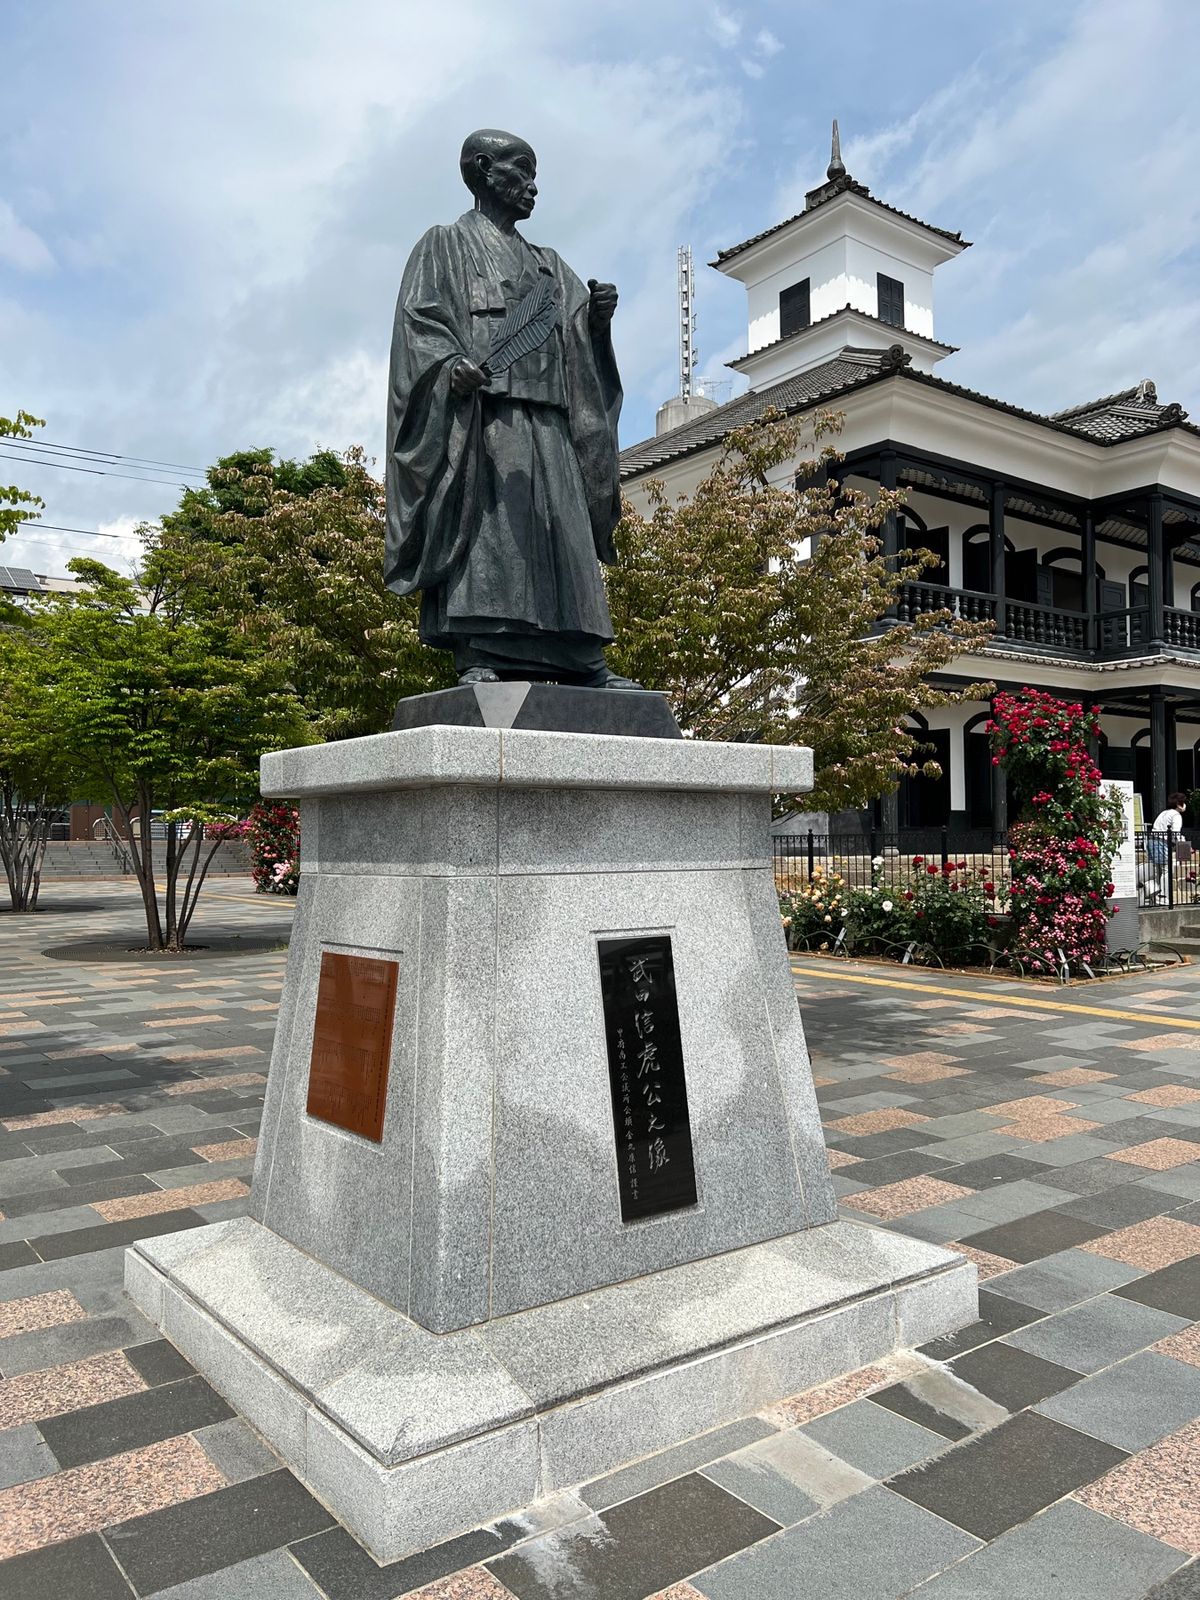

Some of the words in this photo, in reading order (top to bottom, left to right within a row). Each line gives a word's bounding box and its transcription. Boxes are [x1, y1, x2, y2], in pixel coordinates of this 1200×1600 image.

[629, 957, 670, 1175] 武田信虎公之像
